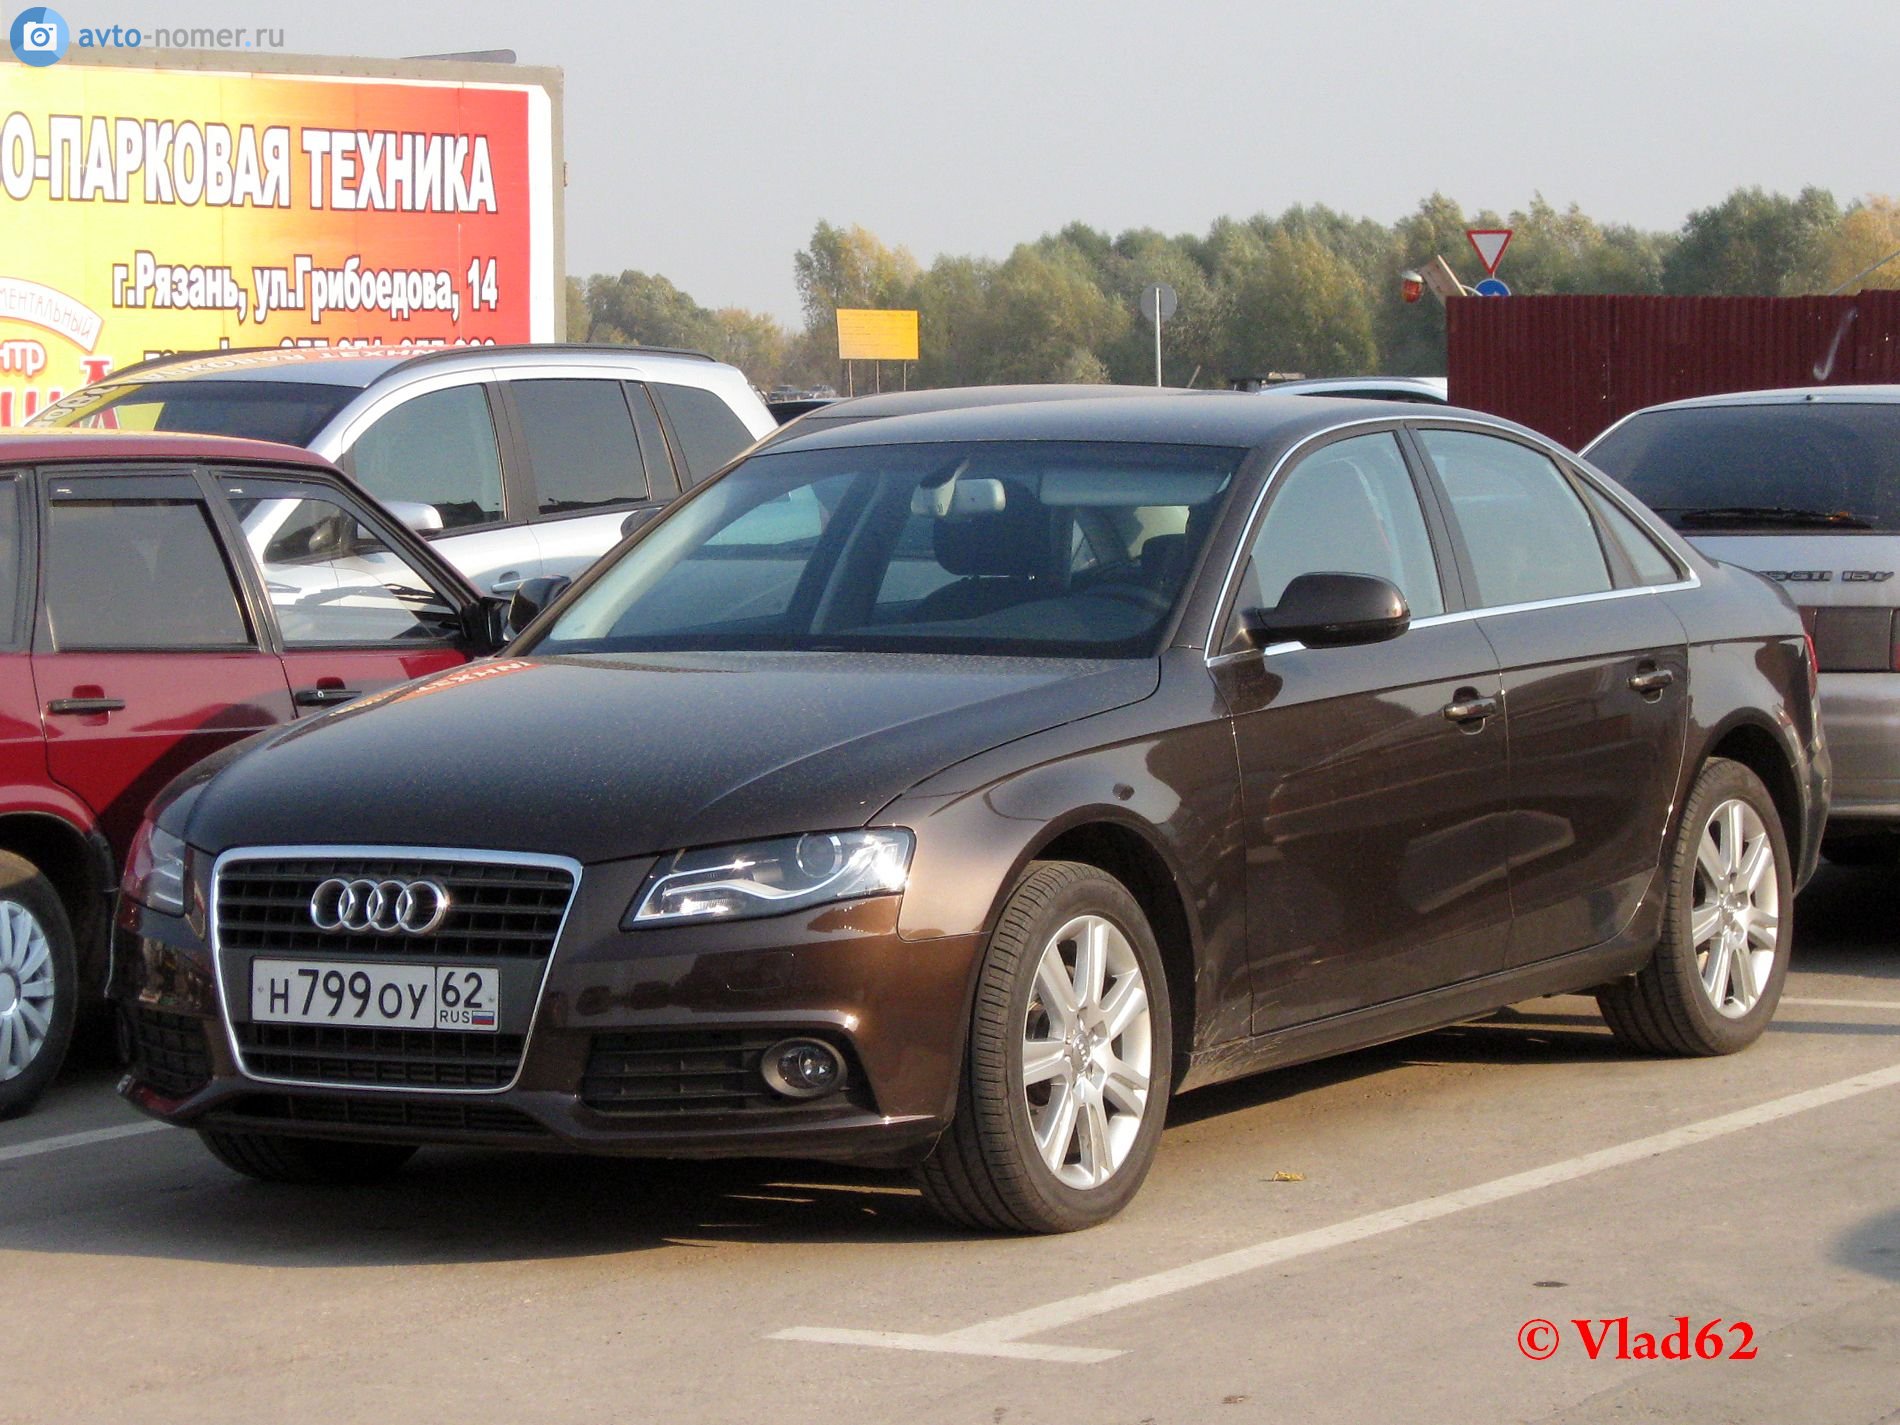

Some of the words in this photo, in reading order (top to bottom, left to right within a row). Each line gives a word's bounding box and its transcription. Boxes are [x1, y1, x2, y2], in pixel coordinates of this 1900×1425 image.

[300, 129, 498, 213] ТЕХНИКА
[467, 255, 499, 313] 14
[441, 971, 483, 1009] 62
[439, 1010, 471, 1025] RUS
